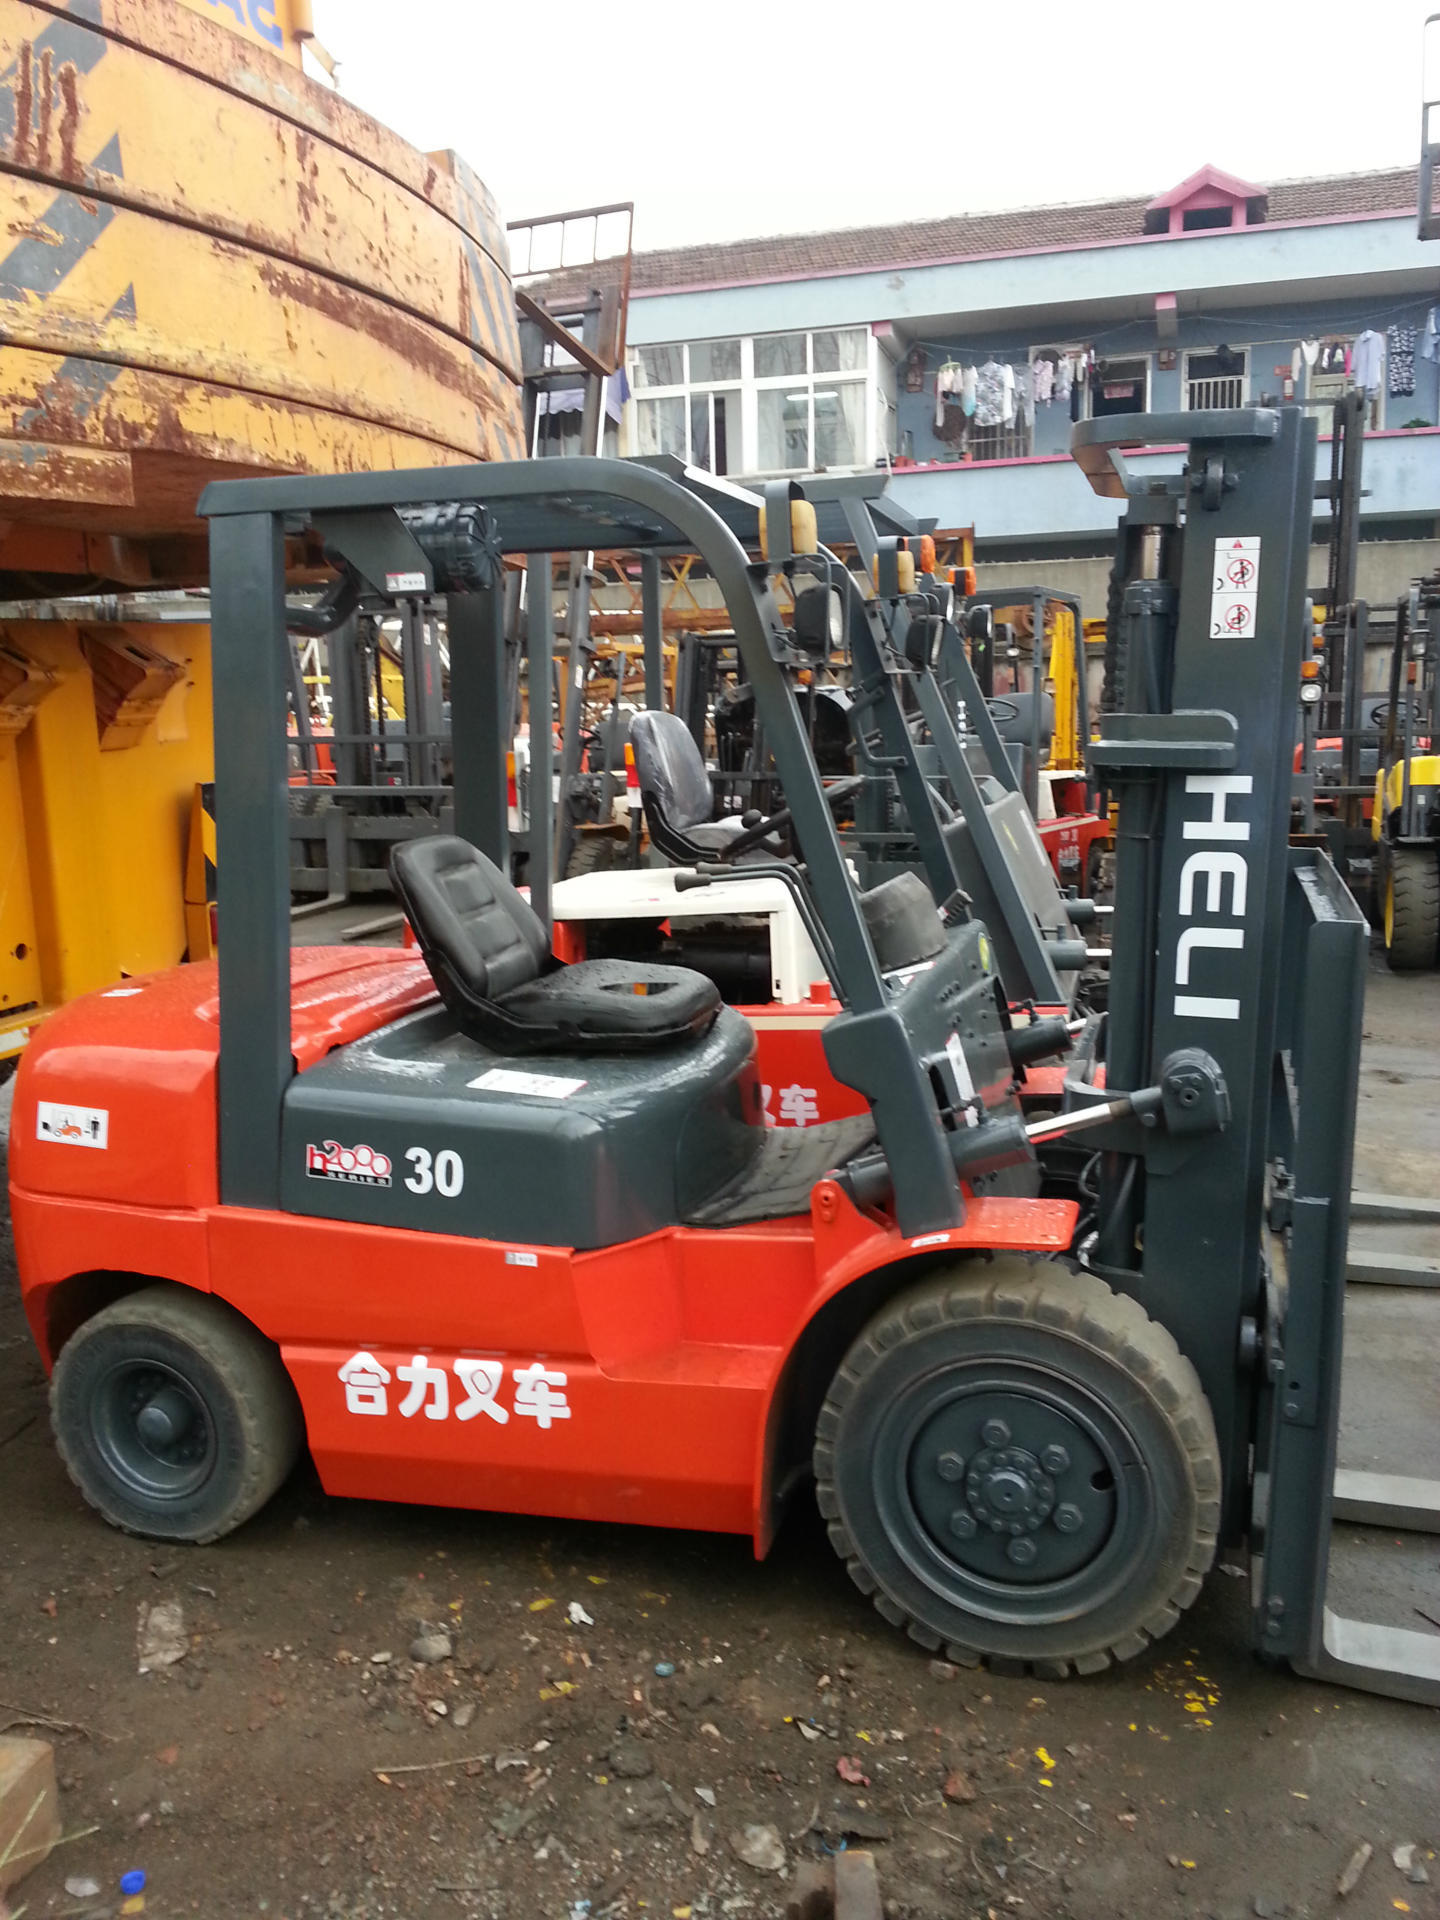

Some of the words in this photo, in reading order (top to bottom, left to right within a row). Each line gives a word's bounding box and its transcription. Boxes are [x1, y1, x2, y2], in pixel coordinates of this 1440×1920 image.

[1173, 775, 1253, 1019] HELI
[326, 1170, 388, 1186] SERIES
[404, 1146, 464, 1198] 30
[337, 1351, 572, 1430] 合力叉车
